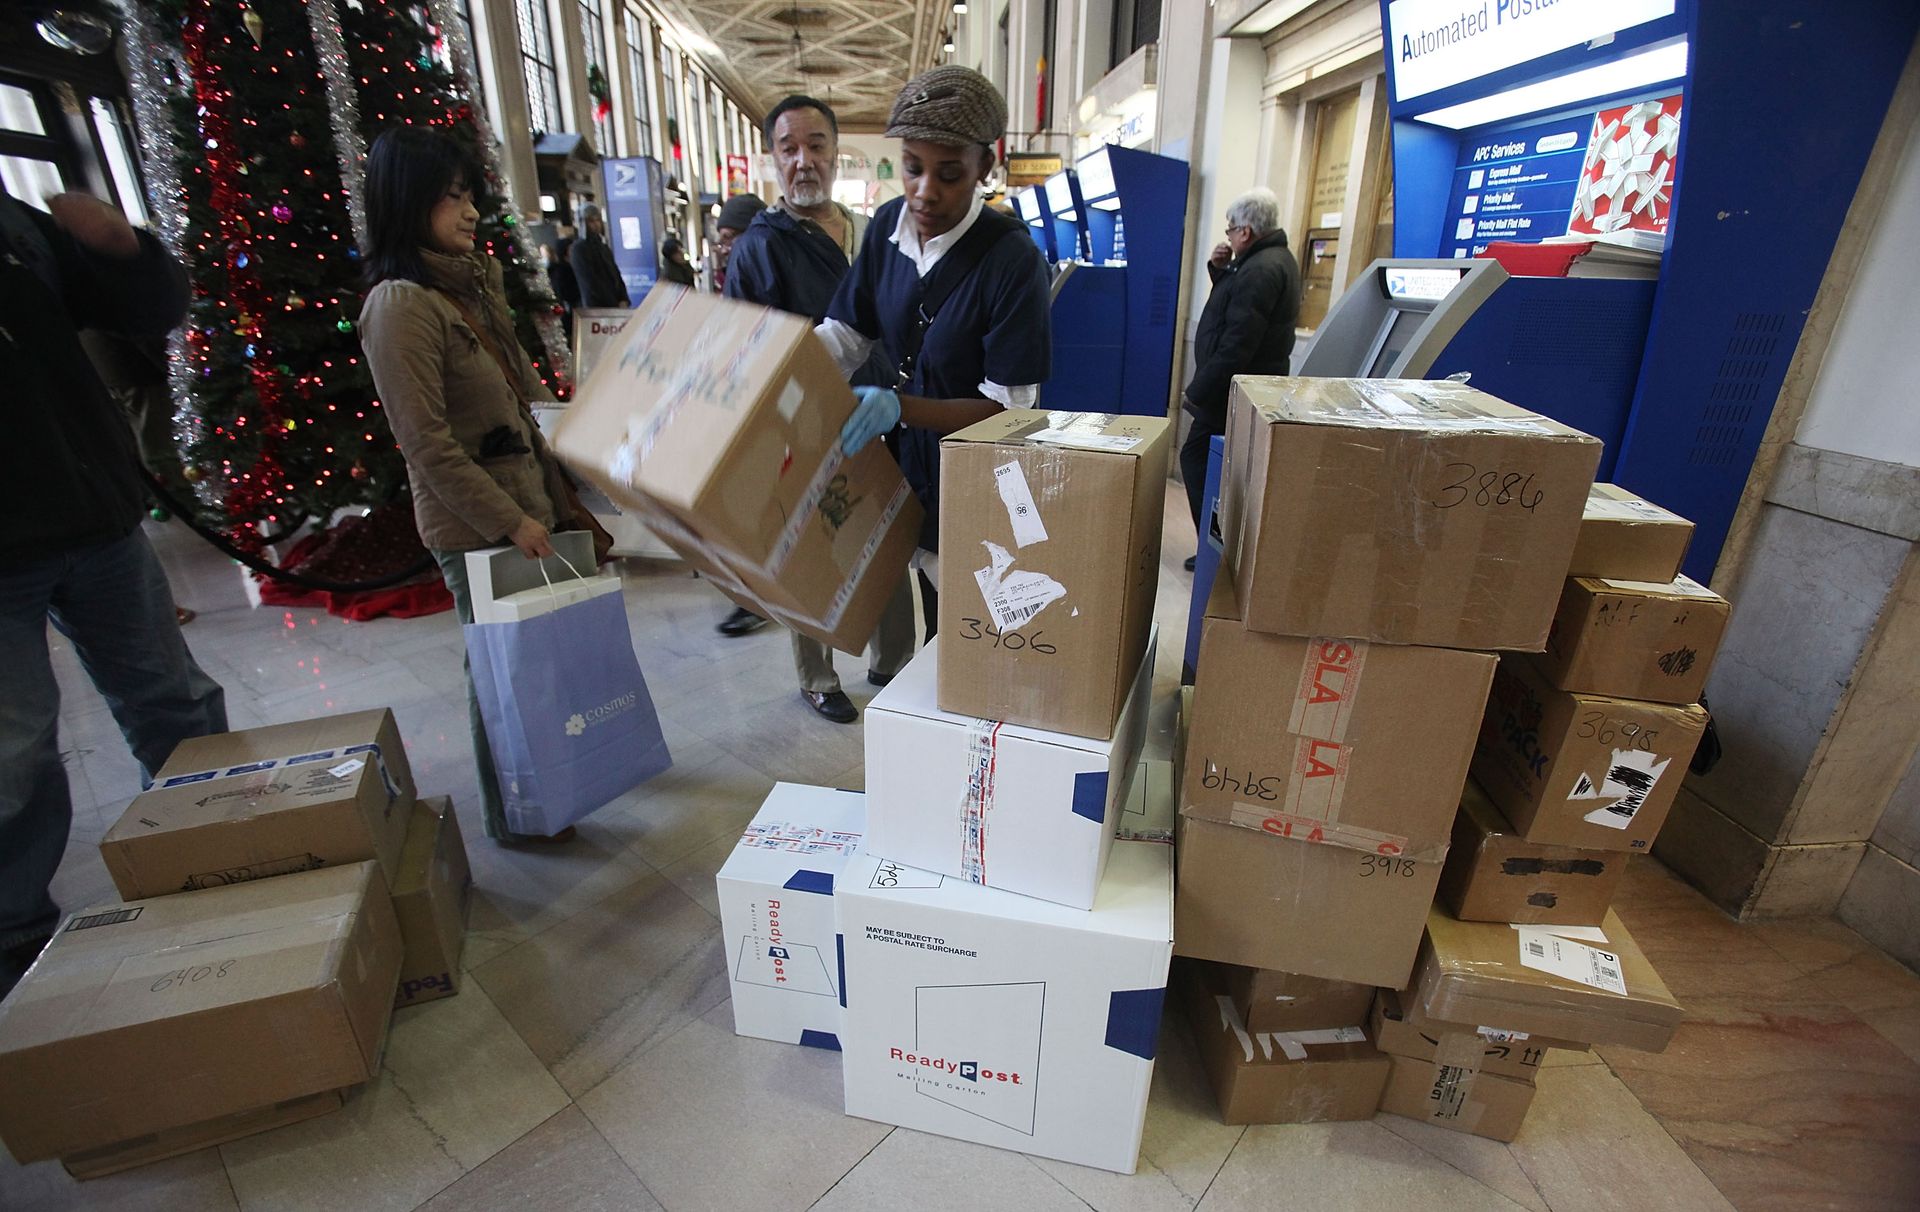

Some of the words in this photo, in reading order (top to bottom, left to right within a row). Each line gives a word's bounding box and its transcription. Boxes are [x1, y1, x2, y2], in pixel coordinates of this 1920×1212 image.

[1402, 2, 1488, 62] Automated
[1491, 142, 1526, 159] Services
[1432, 463, 1544, 514] 3886
[959, 618, 1056, 655] 3406
[1308, 640, 1354, 705] SLA
[1576, 711, 1659, 750] 3698
[1305, 740, 1341, 778] LA
[1630, 839, 1647, 848] 20
[1359, 855, 1416, 878] 3918
[865, 925, 883, 935] MAY
[884, 929, 895, 937] BE
[896, 931, 932, 943] SUBJECT
[933, 937, 945, 945] TO
[873, 934, 904, 945] POSTAL
[905, 940, 926, 949] RATE
[927, 943, 977, 958] SURCHARGE
[1598, 951, 1614, 962] P
[150, 959, 236, 993] 6408
[897, 1072, 940, 1087] Mailing
[946, 1083, 986, 1096] Carton
[1434, 1065, 1450, 1089] Produ
[1430, 1089, 1442, 1101] LD
